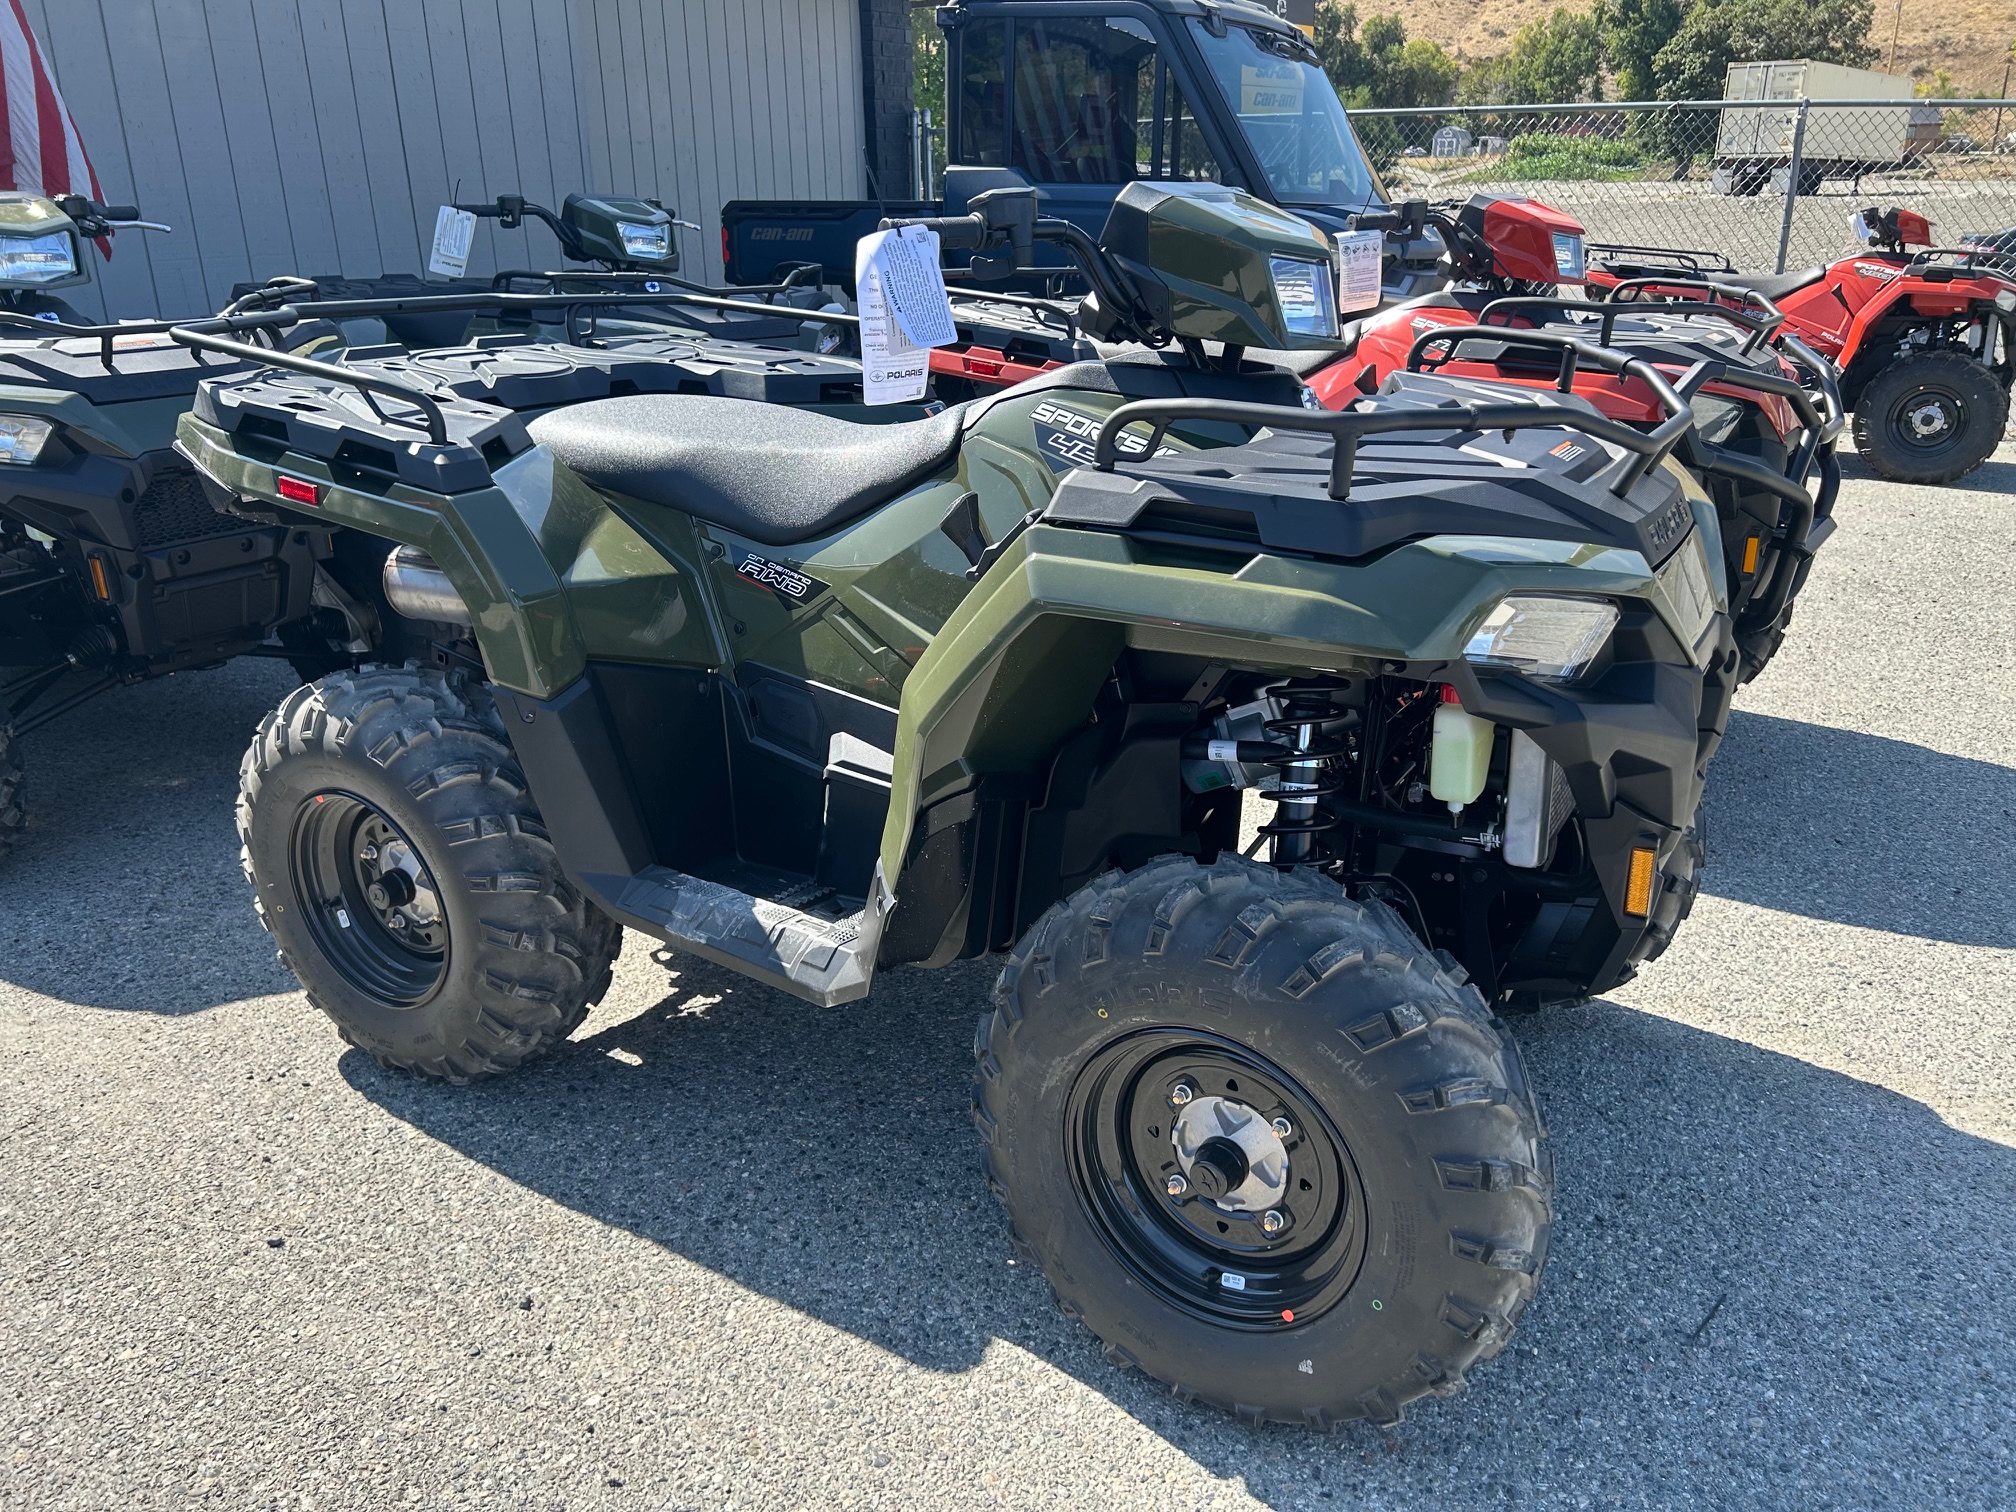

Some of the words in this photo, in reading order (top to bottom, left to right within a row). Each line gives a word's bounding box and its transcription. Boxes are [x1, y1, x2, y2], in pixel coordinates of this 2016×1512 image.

[1253, 92, 1297, 108] can-am
[751, 227, 815, 241] can-am
[884, 270, 899, 306] WARNING
[887, 368, 924, 379] POLARIS
[738, 559, 807, 597] AWD
